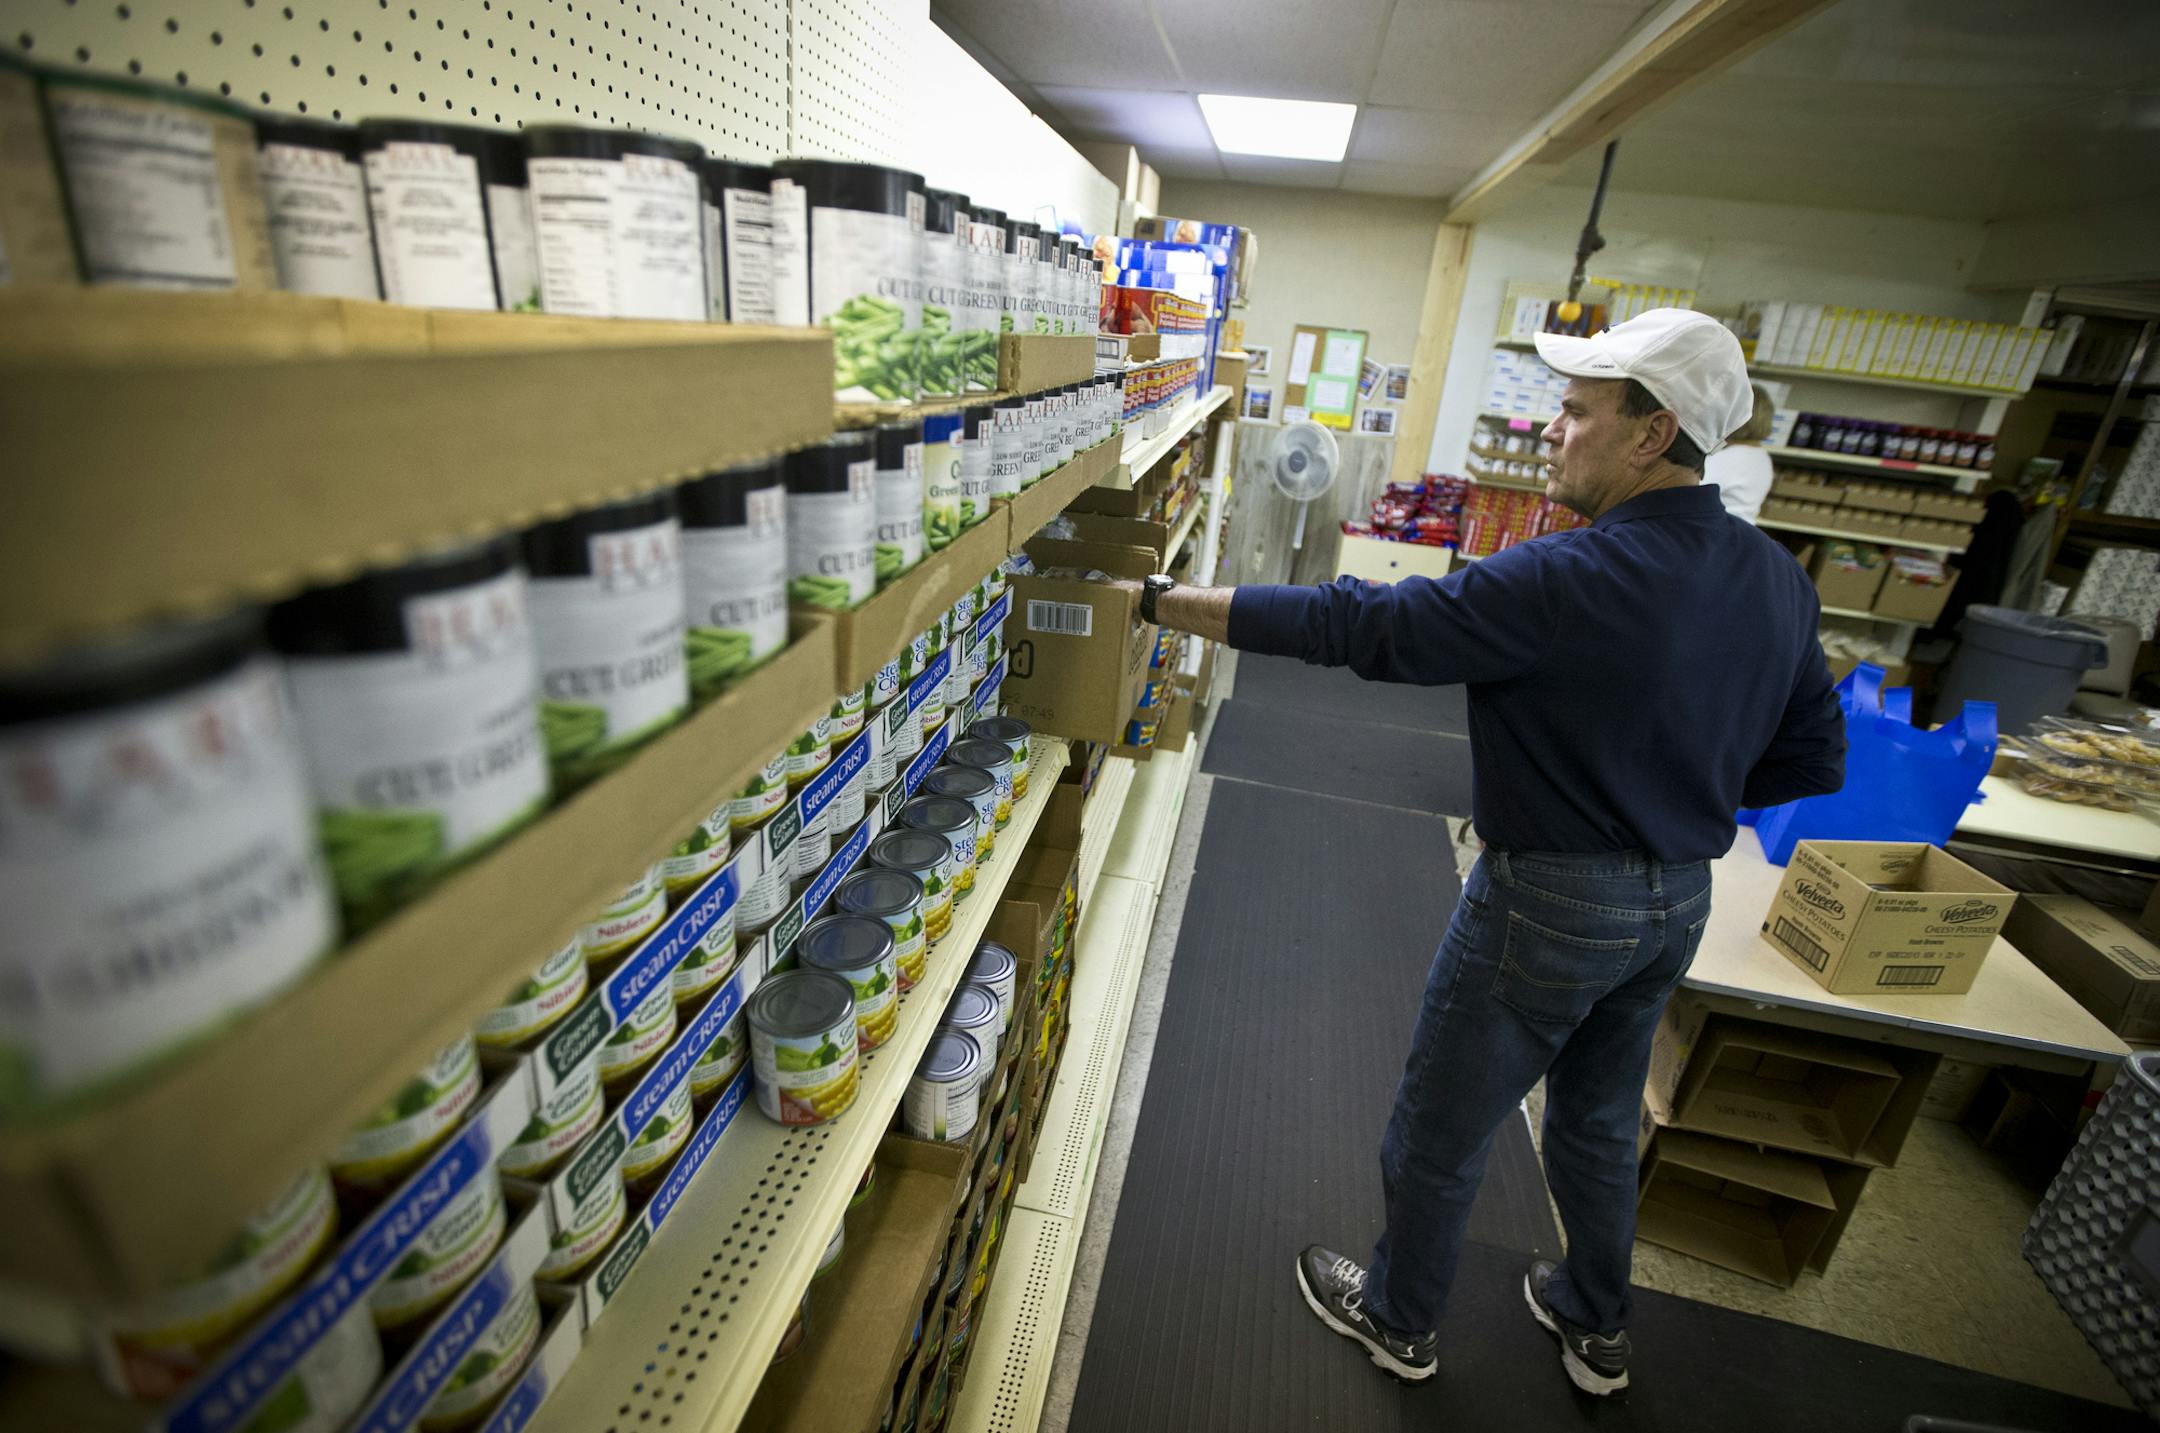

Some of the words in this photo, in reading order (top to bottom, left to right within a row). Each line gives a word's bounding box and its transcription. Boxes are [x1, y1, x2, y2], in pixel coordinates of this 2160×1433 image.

[928, 286, 959, 305] CUT
[878, 521, 909, 541] CUT
[818, 552, 858, 575] CUT
[806, 744, 865, 816] steamCRISP
[807, 832, 864, 911] steamCRISP
[1797, 881, 1845, 914] Velveeta
[1941, 904, 1998, 923] Velveeta
[619, 885, 726, 1009] steamCRISP
[632, 991, 732, 1125] steamCRISP
[657, 1082, 744, 1217] steamCRISP
